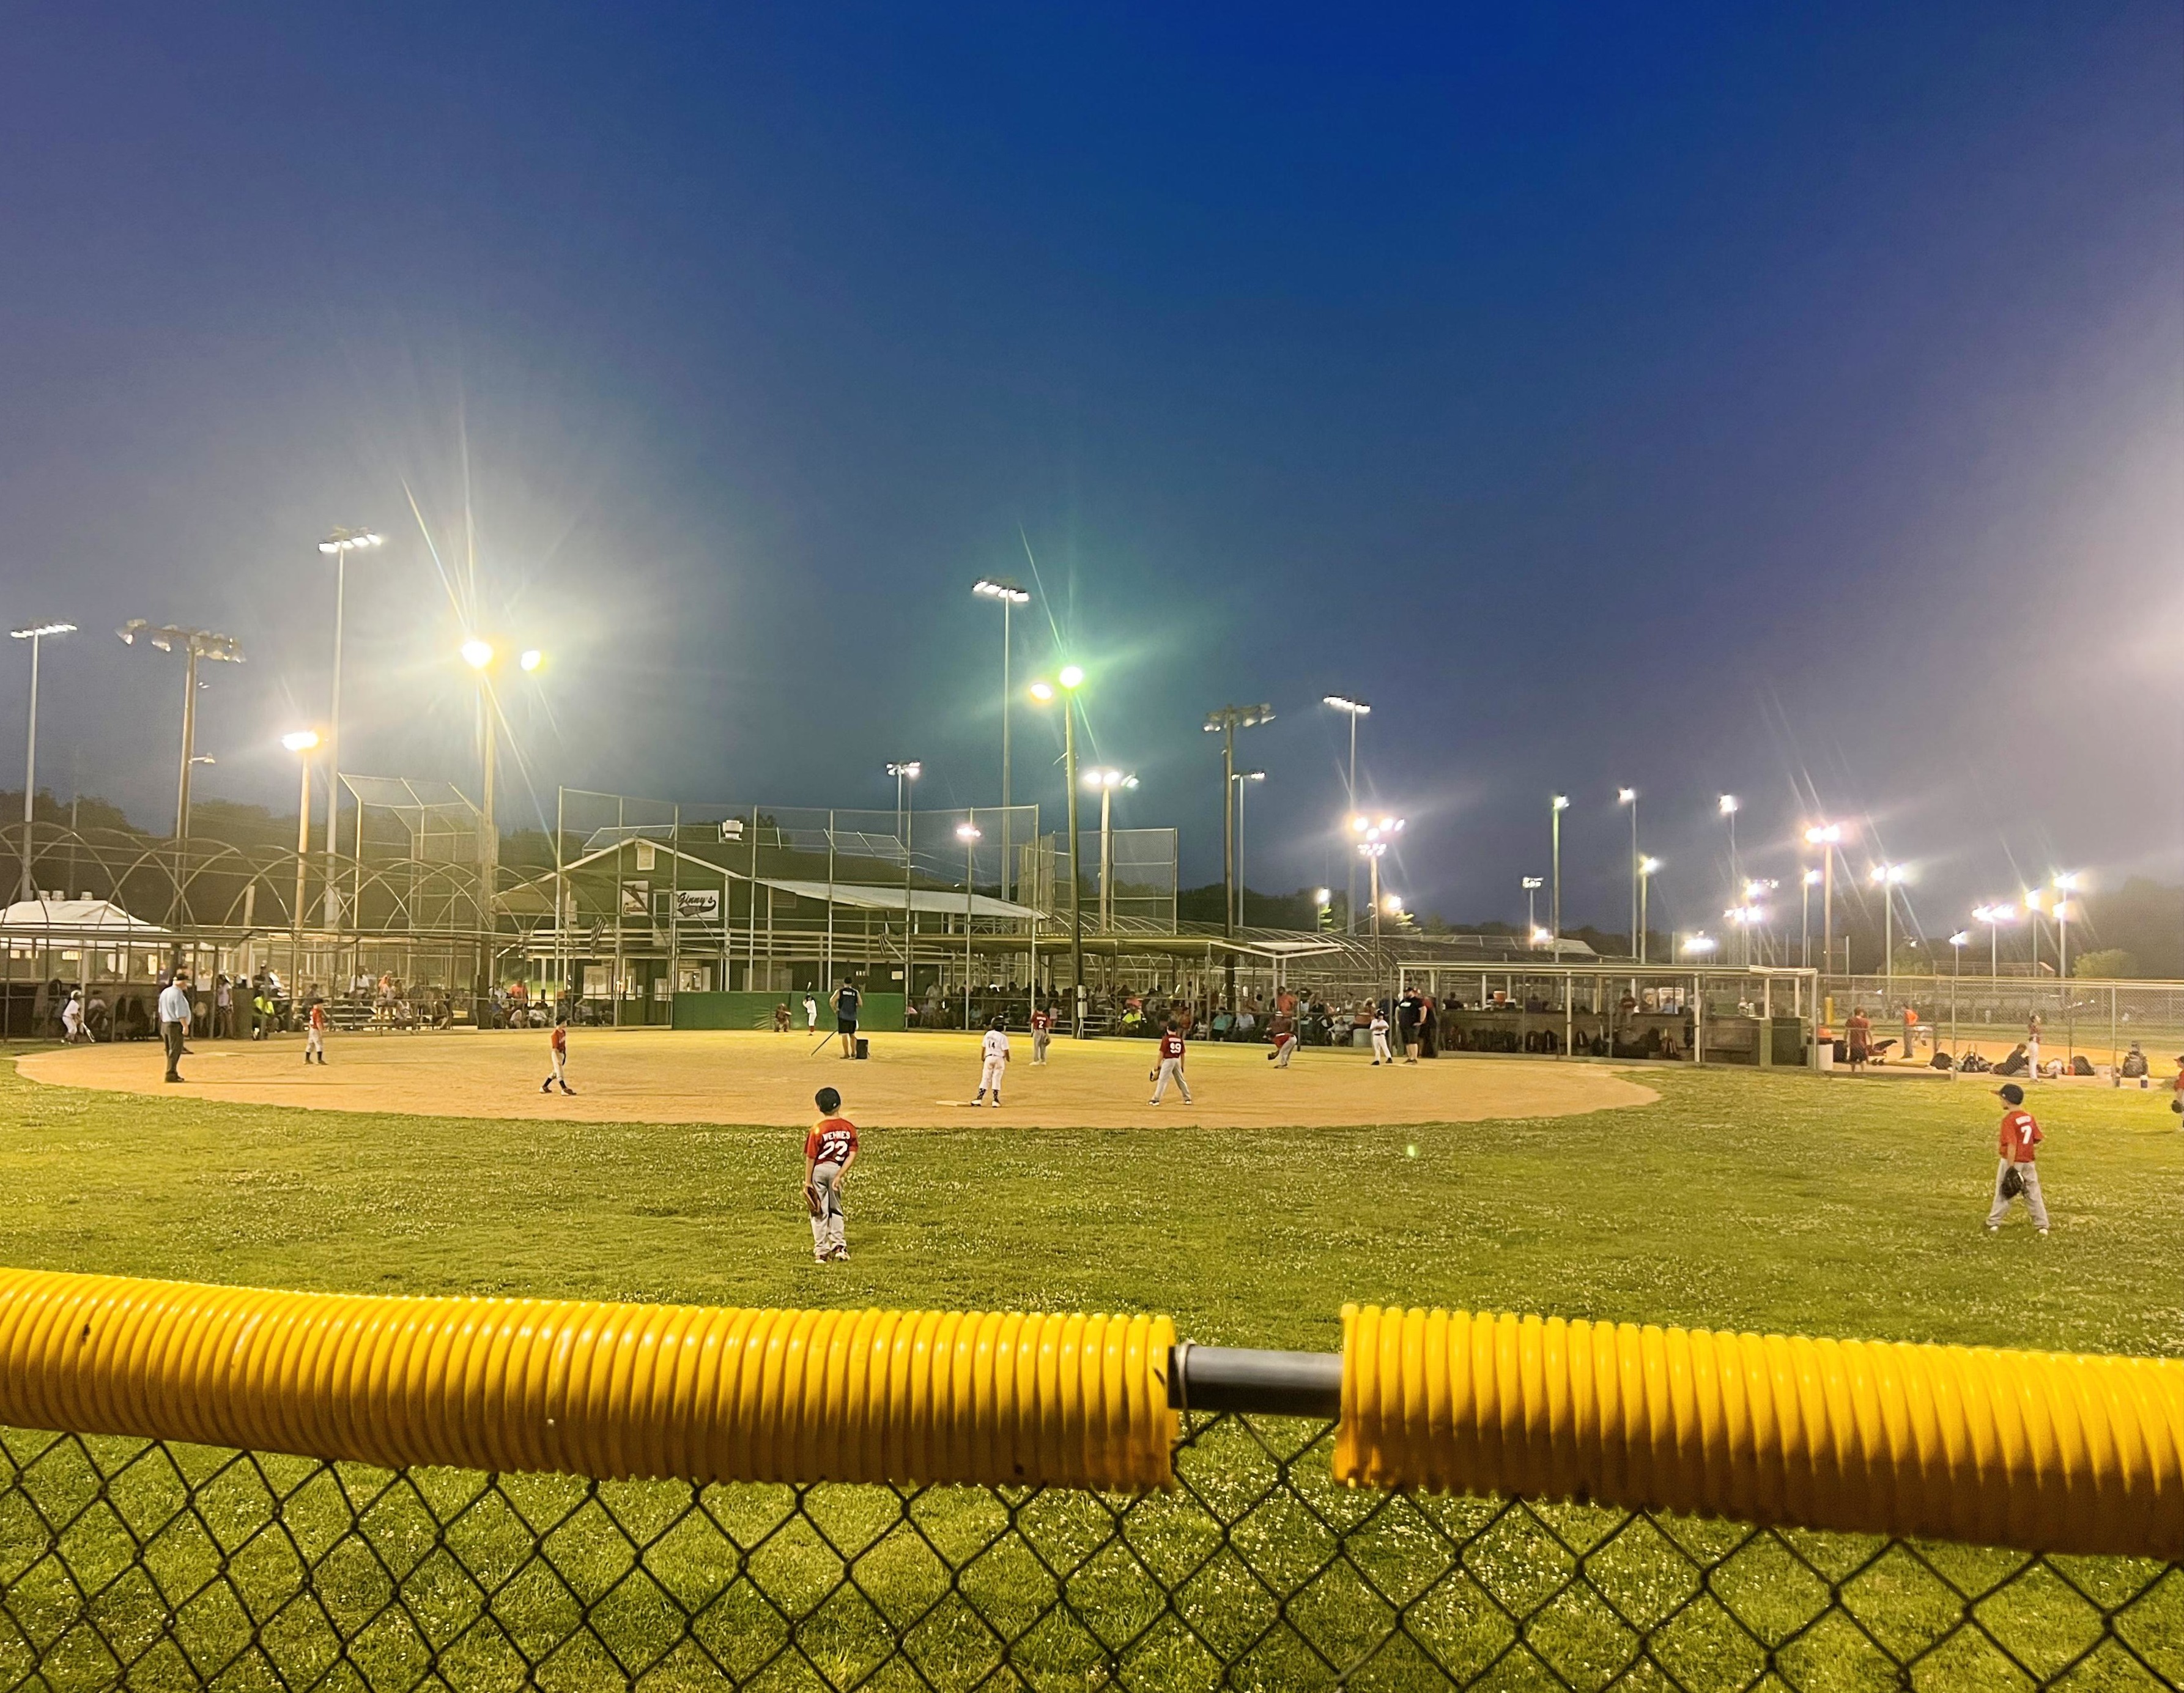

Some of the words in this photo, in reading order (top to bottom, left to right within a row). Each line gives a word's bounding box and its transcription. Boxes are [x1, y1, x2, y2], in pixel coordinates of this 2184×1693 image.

[1038, 1020, 1044, 1029] 2
[988, 1040, 996, 1049] 14
[1170, 1042, 1182, 1054] 99
[2021, 1125, 2032, 1144] 7
